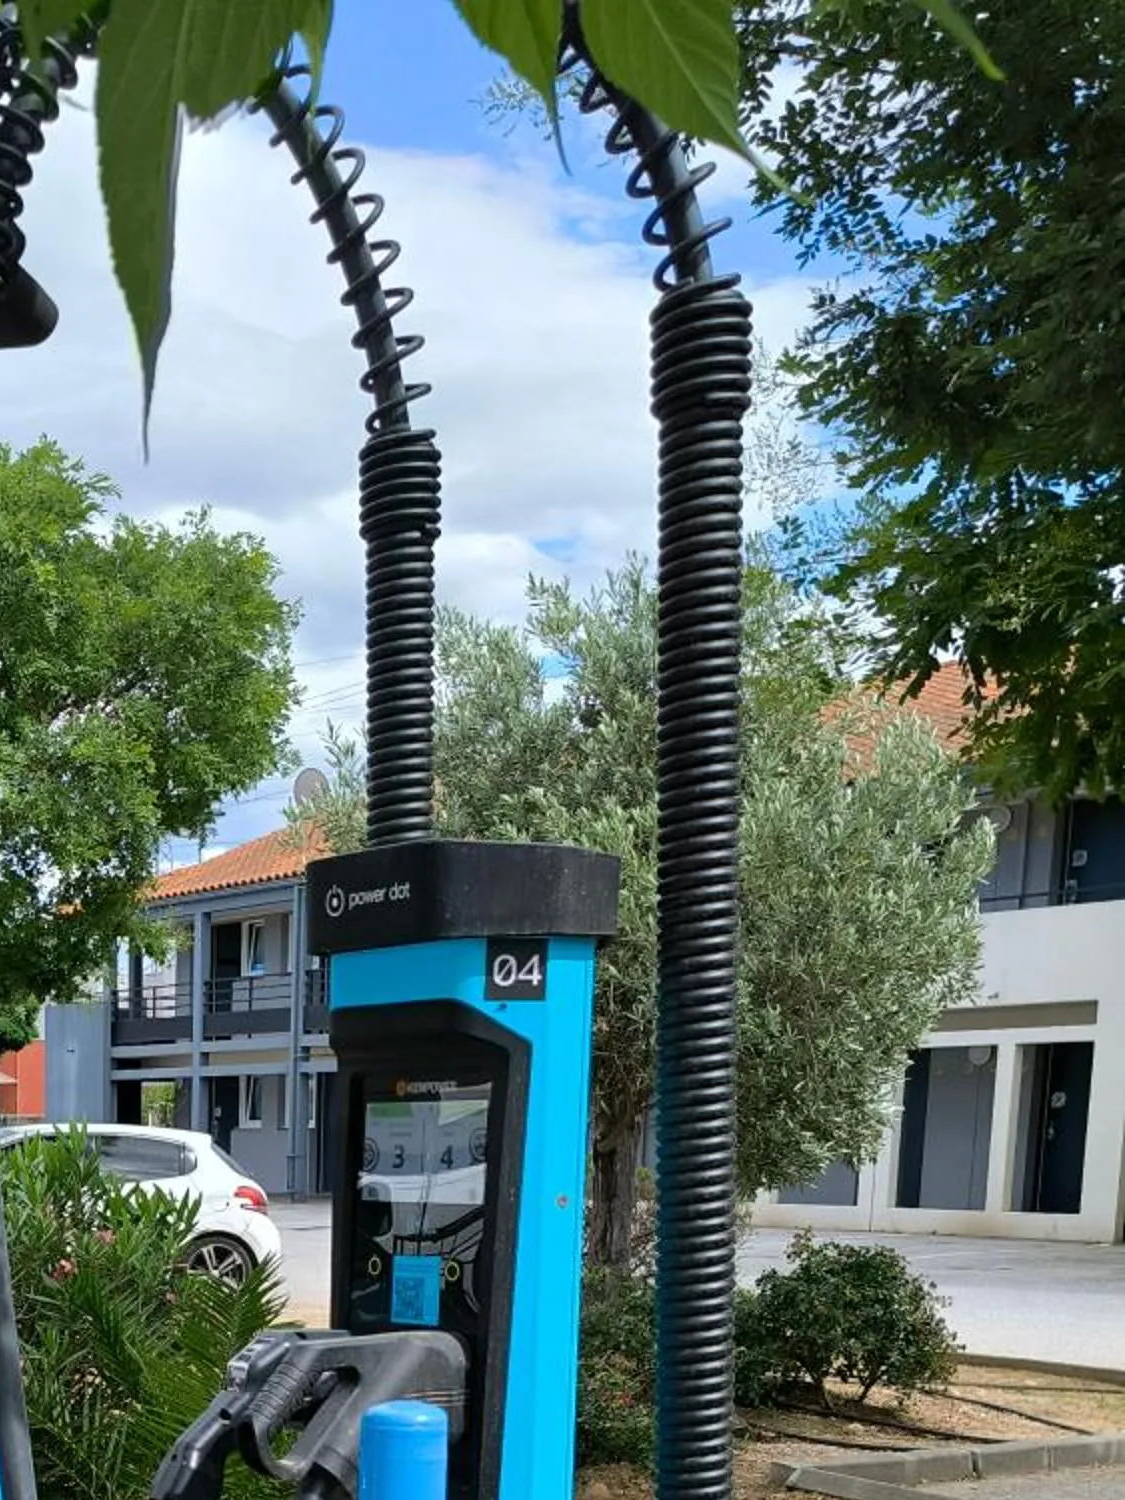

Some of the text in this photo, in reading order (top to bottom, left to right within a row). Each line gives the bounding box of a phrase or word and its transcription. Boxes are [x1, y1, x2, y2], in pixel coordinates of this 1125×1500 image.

[348, 881, 410, 911] power dot
[492, 953, 543, 987] 04
[392, 1144, 405, 1169] 3
[440, 1144, 454, 1169] 4
